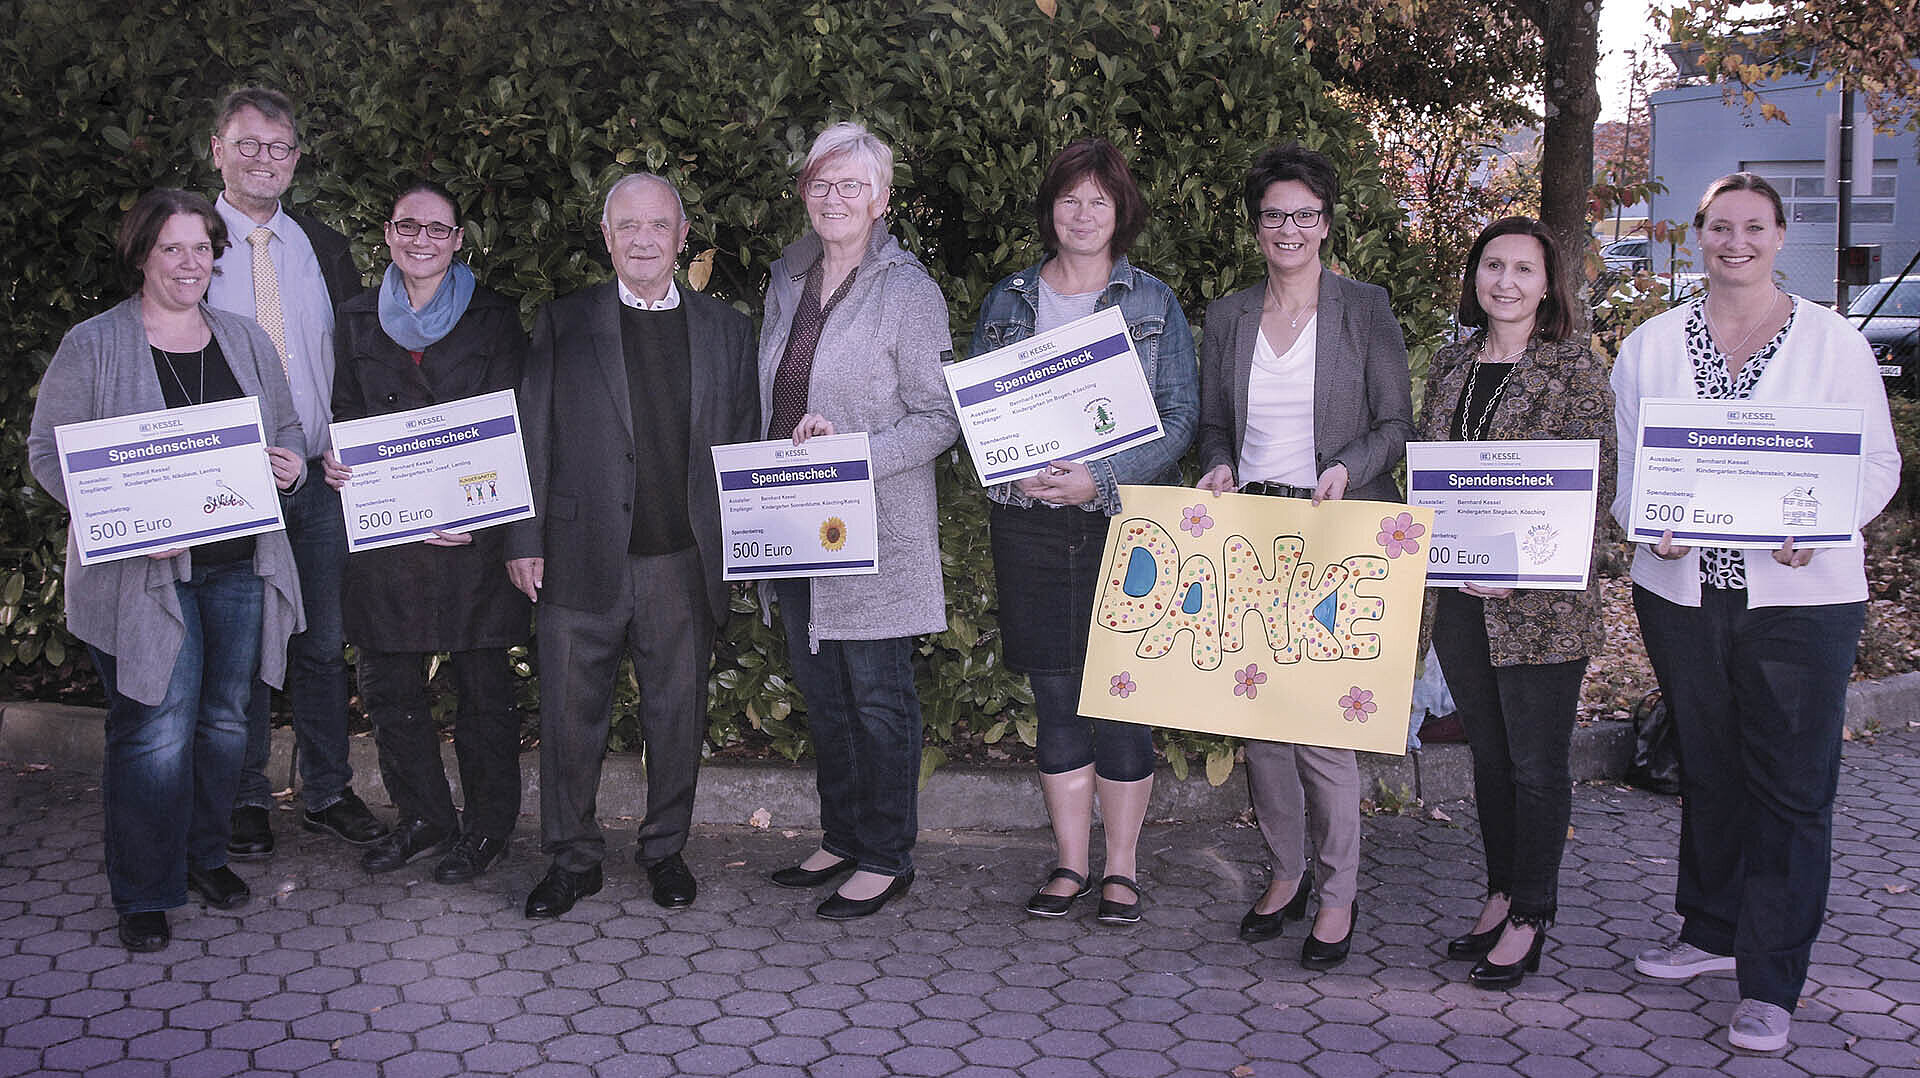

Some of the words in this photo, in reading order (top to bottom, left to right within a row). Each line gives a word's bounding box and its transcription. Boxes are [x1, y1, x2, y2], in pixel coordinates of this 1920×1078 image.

[1029, 341, 1056, 356] KESSEL
[994, 349, 1094, 393] Spendenscheck
[152, 419, 184, 431] KESSEL
[418, 416, 446, 427] KESSEL
[1742, 412, 1776, 421] KESSEL
[108, 433, 222, 464] Spendenscheck
[377, 426, 480, 458] Spendenscheck
[1687, 432, 1815, 449] Spendenscheck
[785, 448, 809, 458] KESSEL
[985, 446, 1019, 466] 500
[1025, 440, 1060, 457] Euro
[1492, 452, 1521, 461] KESSEL
[751, 466, 838, 486] Spendenscheck
[1695, 467, 1737, 475] Kindergarten
[1448, 473, 1554, 488] Spendenscheck
[358, 510, 393, 530] 500
[399, 508, 433, 523] Euro
[1645, 503, 1686, 523] 500
[1693, 509, 1734, 525] Euro
[89, 520, 127, 542] 500
[134, 516, 172, 534] Euro
[733, 541, 760, 559] 500
[764, 543, 793, 557] Euro
[1428, 546, 1451, 564] 00
[1457, 550, 1490, 565] Euro
[1097, 517, 1390, 672] DANKE
